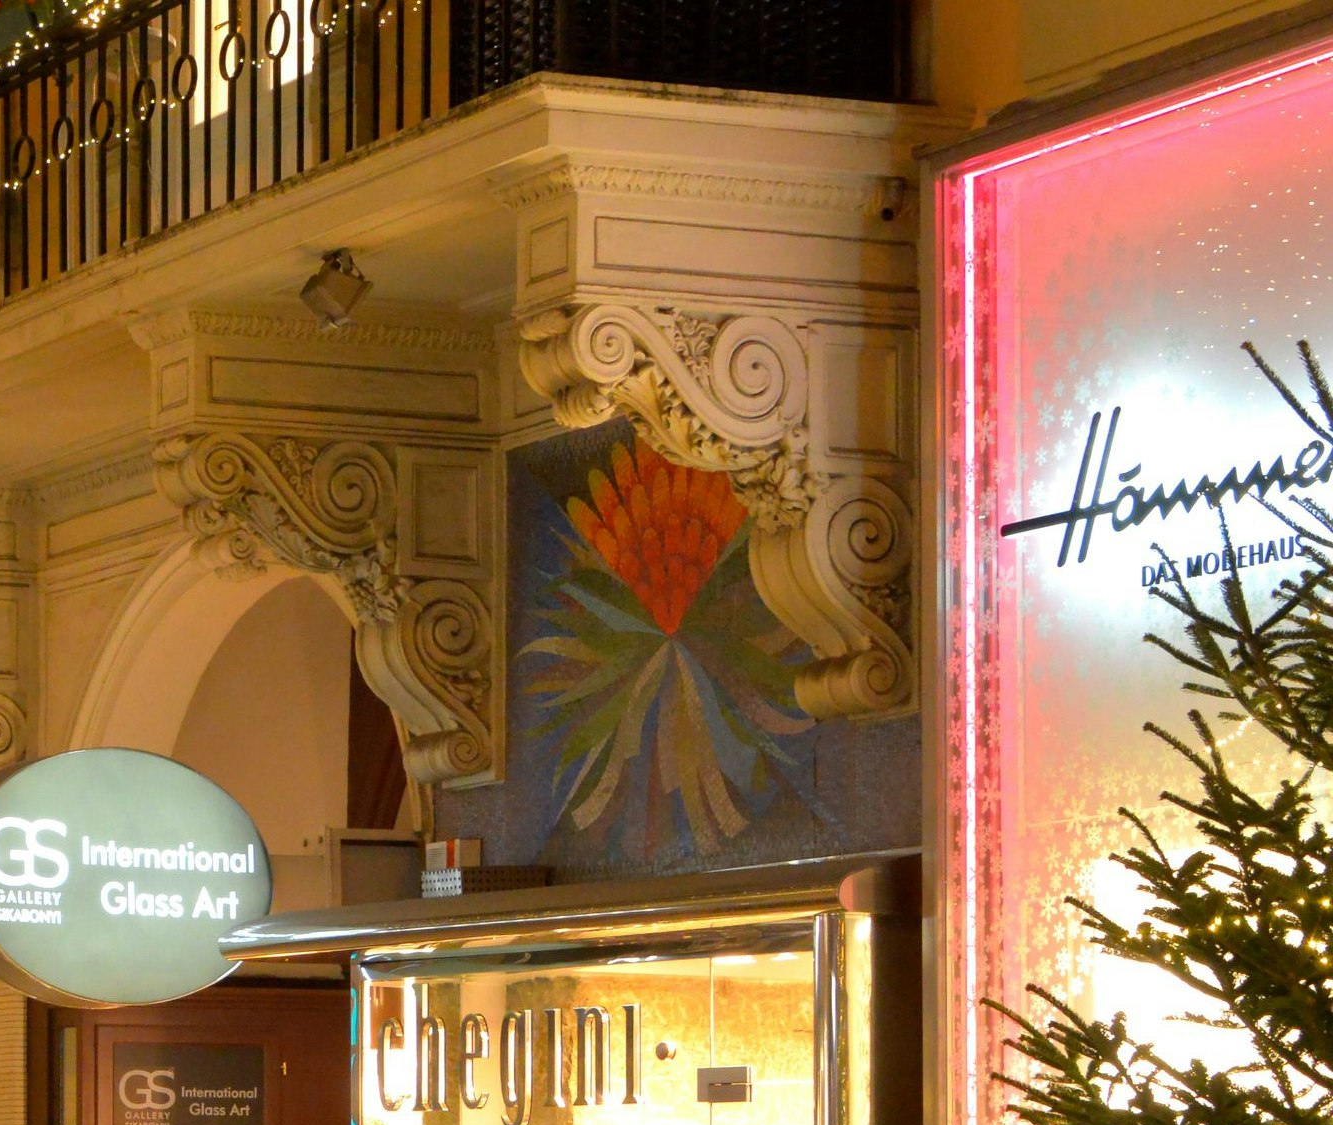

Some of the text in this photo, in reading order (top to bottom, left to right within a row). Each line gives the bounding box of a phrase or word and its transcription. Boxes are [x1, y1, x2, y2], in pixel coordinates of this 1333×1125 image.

[81, 835, 255, 874] International
[100, 881, 240, 920] Glass Art
[118, 1069, 177, 1110] GS
[181, 1086, 258, 1099] International
[124, 1111, 171, 1121] GALLERY
[189, 1102, 251, 1117] Glass Art
